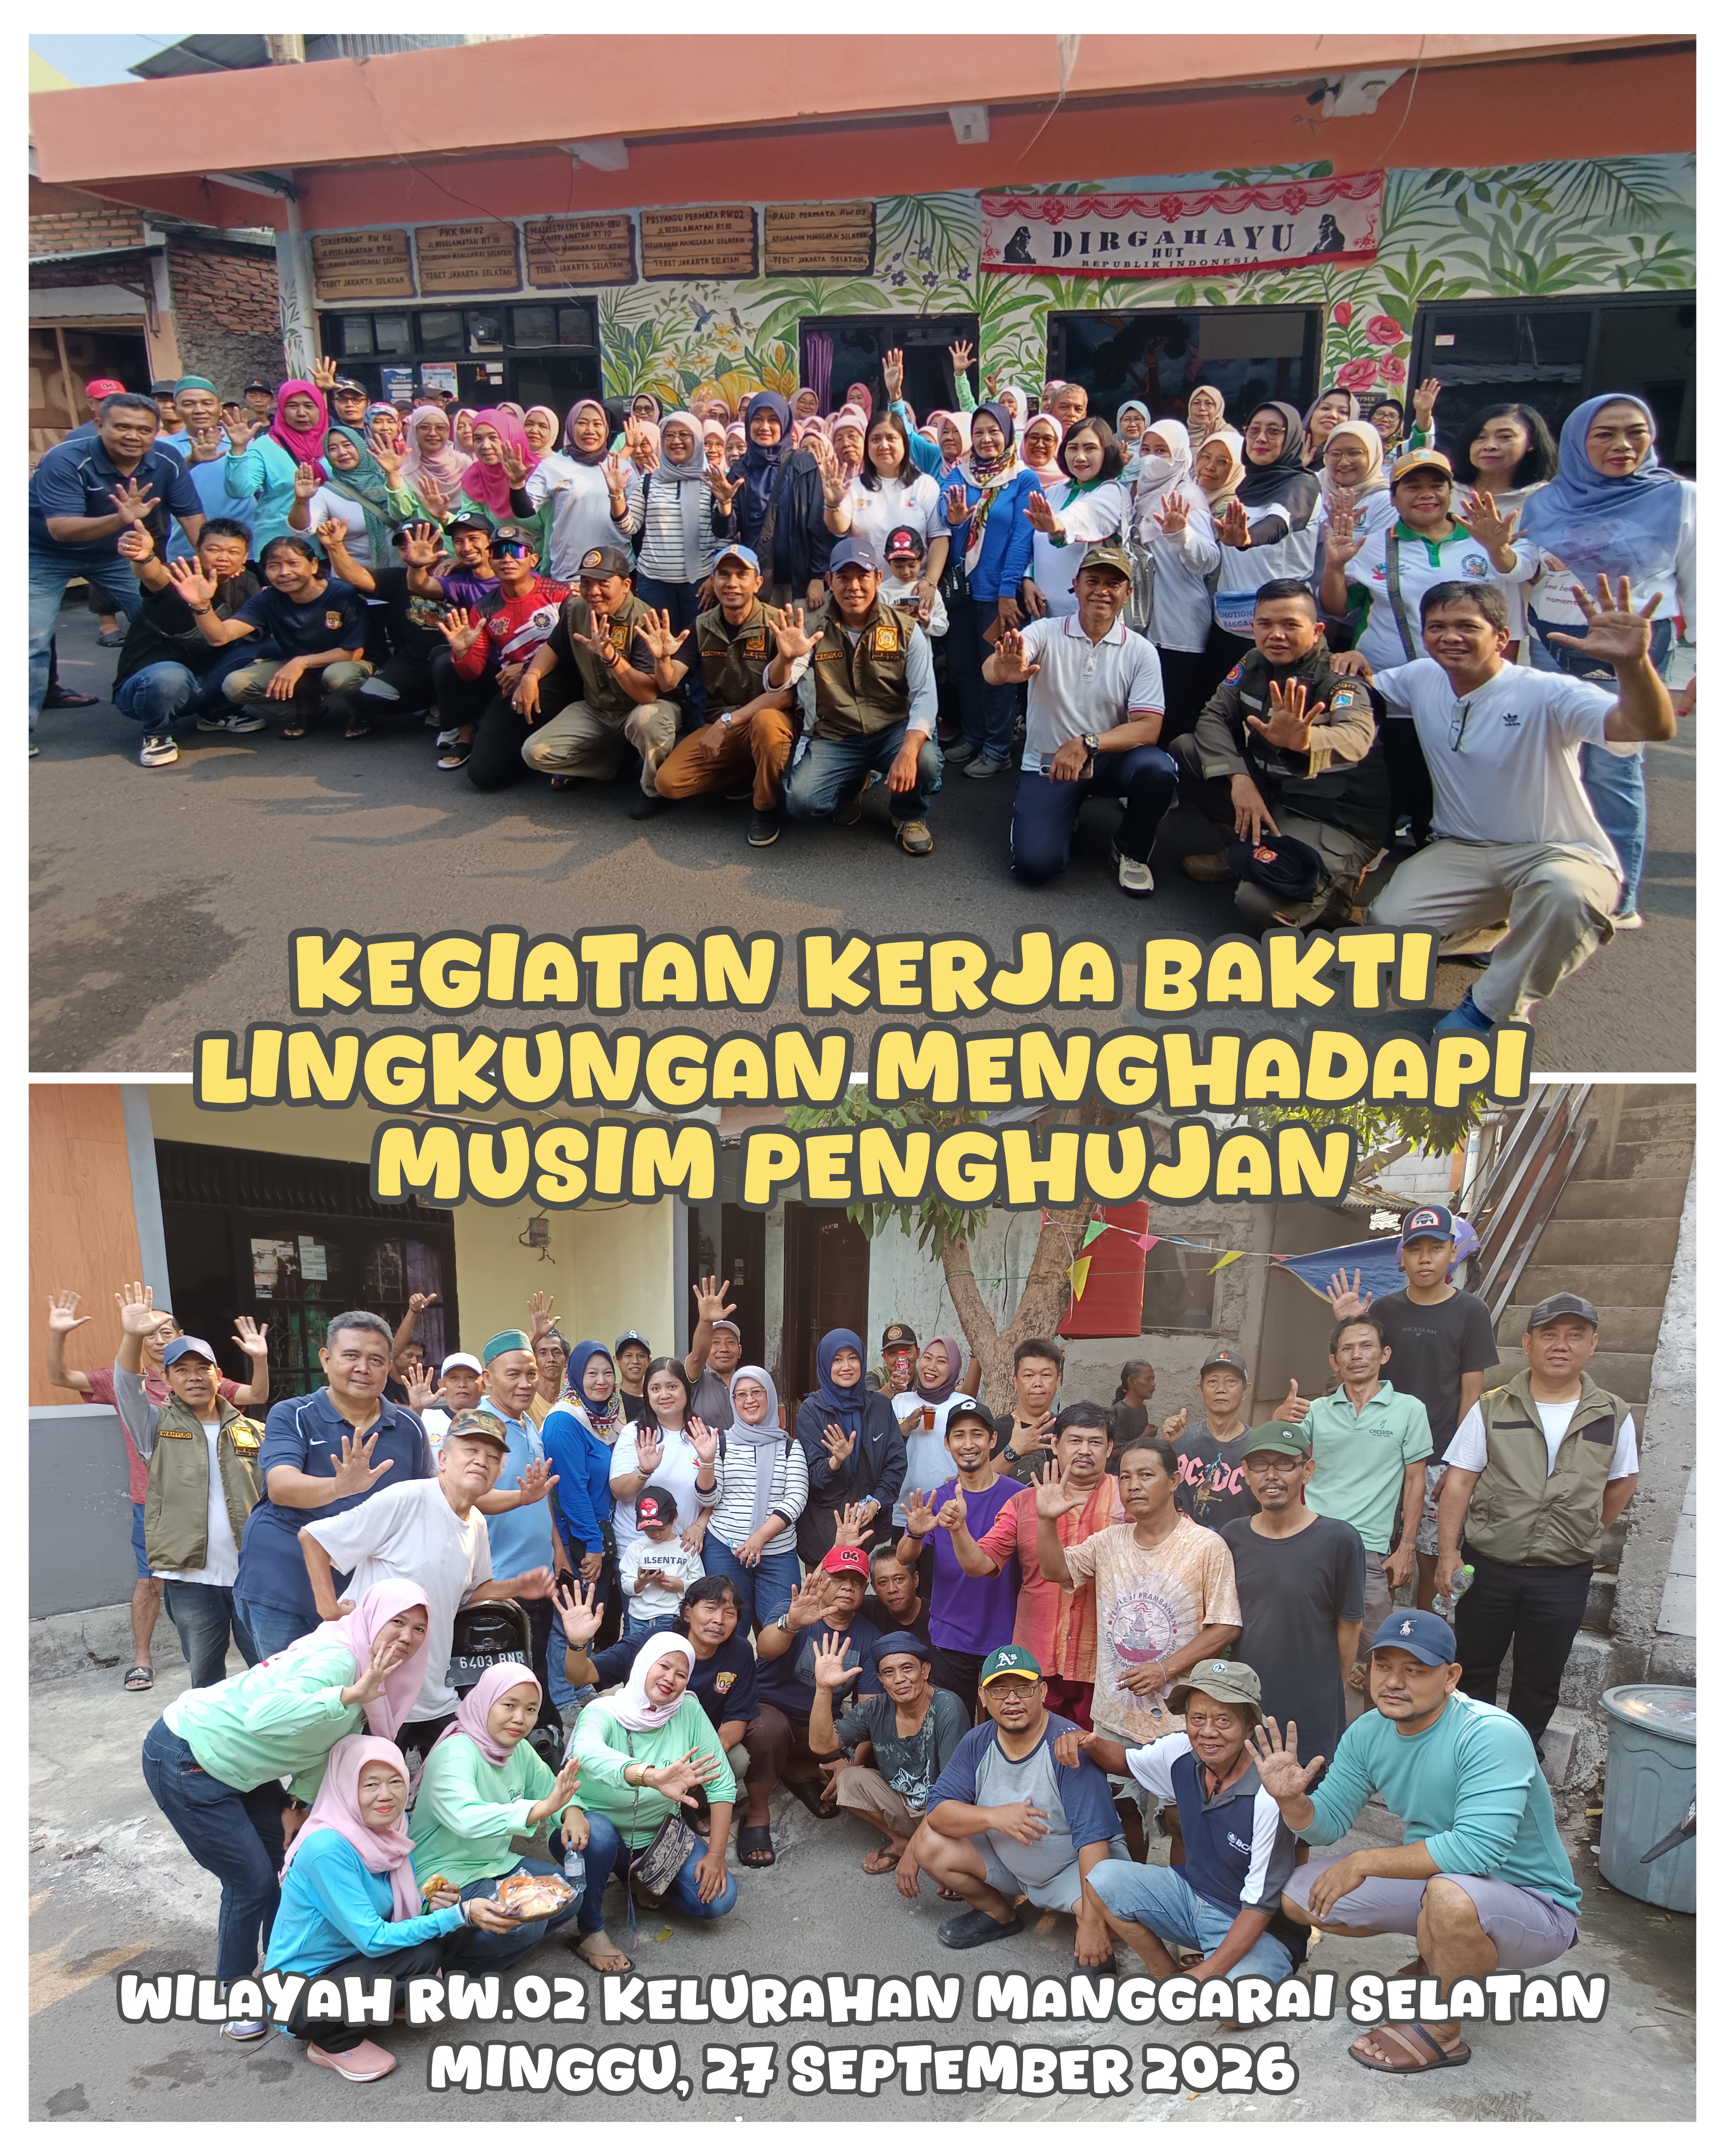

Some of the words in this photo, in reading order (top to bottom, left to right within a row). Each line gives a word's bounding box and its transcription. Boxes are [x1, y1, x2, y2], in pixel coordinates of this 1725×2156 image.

[646, 214, 683, 224] POSYANDU
[685, 211, 719, 221] PERMATA
[773, 212, 796, 221] PAUD
[799, 211, 836, 219] PERMATA
[580, 220, 621, 231] BAPAK-IBU
[665, 224, 713, 233] KESELAMATAN
[439, 228, 458, 237] PKK
[321, 235, 363, 246] SEKERTARIAT
[679, 238, 714, 247] MANGGARAI
[772, 235, 805, 243] KELURAHAN
[1052, 224, 1295, 258] DIRGAHAYU
[598, 243, 628, 251] SELATAN
[1152, 247, 1184, 258] HUT
[383, 257, 408, 265] SELATAN
[654, 259, 676, 267] TEBET
[678, 258, 710, 266] JAKARTA
[711, 256, 740, 265] SELATAN
[1081, 260, 1160, 269] REPUBLIK
[1169, 256, 1259, 269] INDONESIA
[535, 266, 556, 275] TEBET
[560, 263, 590, 272] JAKARTA
[593, 261, 623, 270] SELATAN
[425, 272, 446, 280] TEBET
[449, 270, 479, 279] JAKARTA
[482, 269, 512, 277] SELATAN
[322, 280, 341, 288] TEBET
[343, 278, 374, 286] JAKARTA
[376, 277, 404, 285] SELATAN
[1219, 610, 1253, 618] EMOTION
[629, 1330, 638, 1339] S
[1402, 1326, 1437, 1334] WICKSRAM
[161, 1430, 191, 1438] WAHYUDI
[842, 1551, 859, 1562] 04
[1138, 1593, 1178, 1627] PRAMBANAN
[1154, 1639, 1177, 1663] onesia
[459, 1654, 493, 1669] 6403
[499, 1652, 525, 1663] BNR
[996, 1652, 1018, 1669] A's
[719, 1680, 732, 1688] 02
